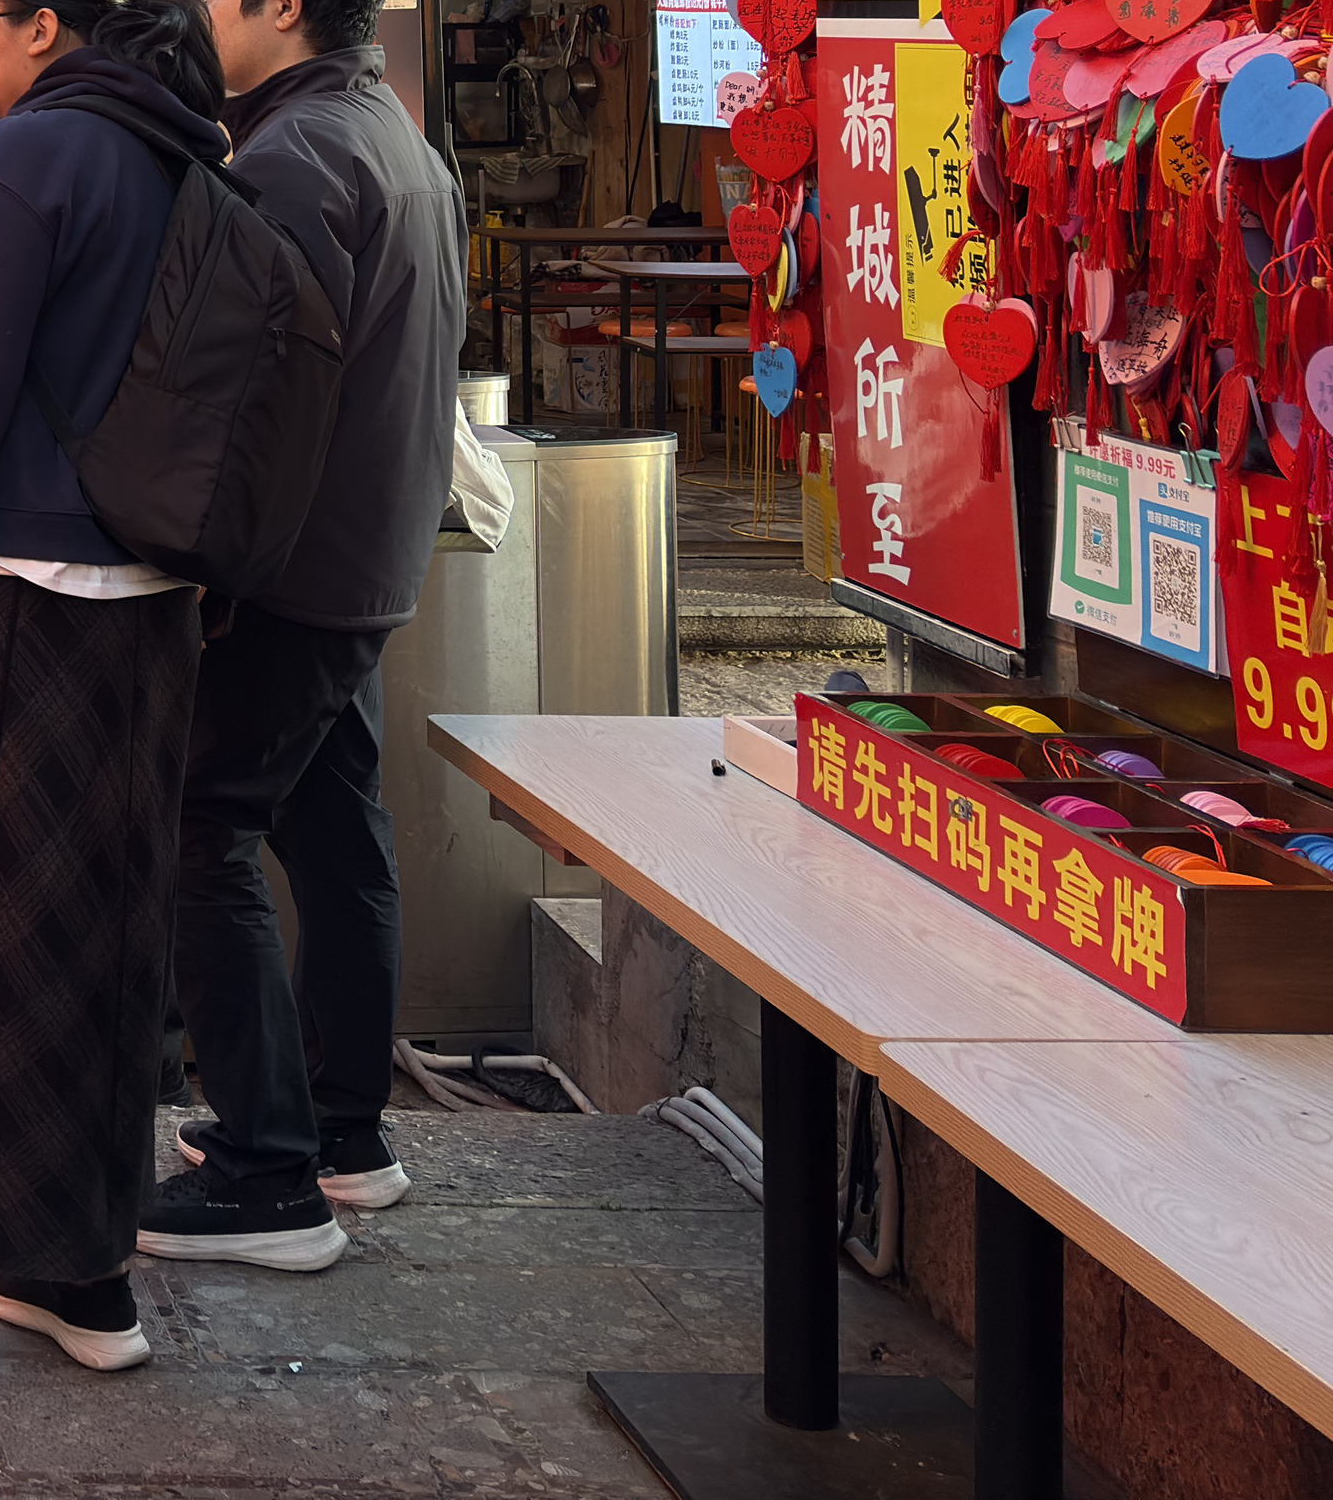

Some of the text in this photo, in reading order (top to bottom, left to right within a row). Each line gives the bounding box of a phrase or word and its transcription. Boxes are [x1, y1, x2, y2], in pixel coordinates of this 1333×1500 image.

[840, 63, 911, 587] 精城所至
[1136, 453, 1177, 480] 9.99元
[1168, 487, 1191, 504] 支付宝
[1146, 509, 1203, 539] 推荐使用支付宝
[1242, 655, 1333, 752] 9.9
[807, 716, 1168, 991] 请先扫码再拿牌
